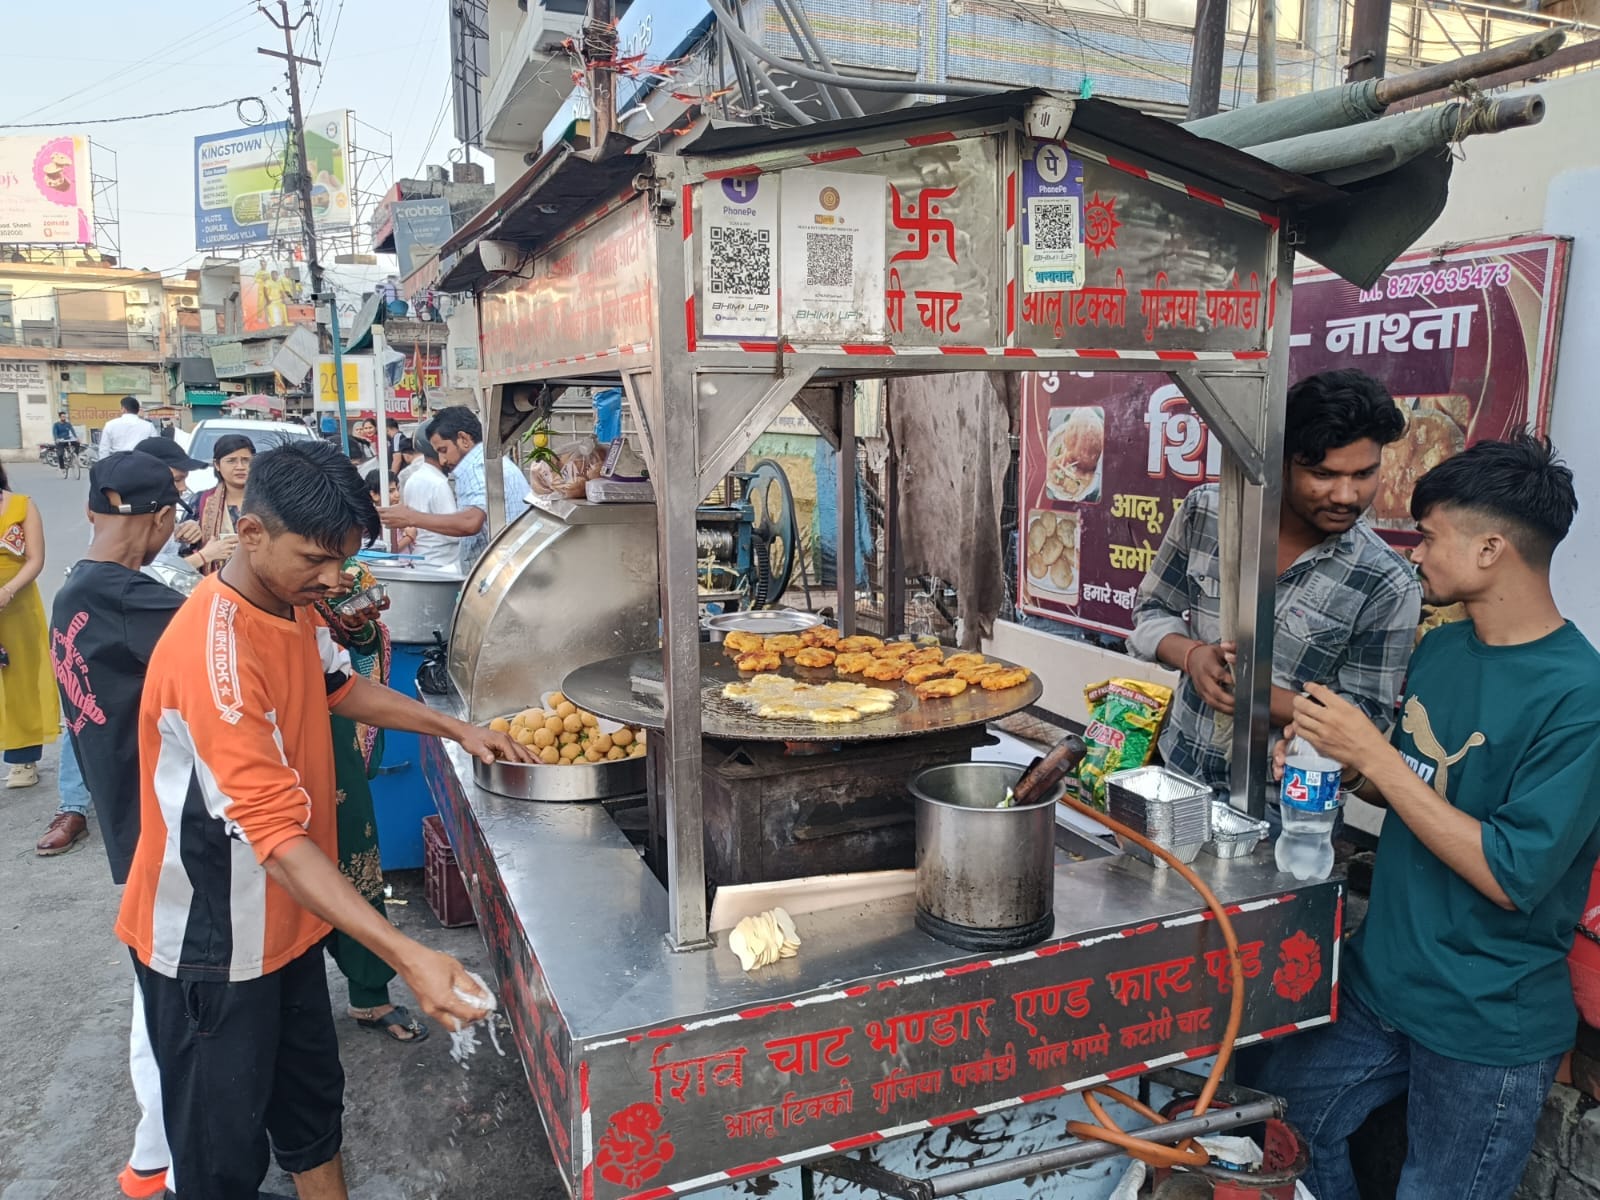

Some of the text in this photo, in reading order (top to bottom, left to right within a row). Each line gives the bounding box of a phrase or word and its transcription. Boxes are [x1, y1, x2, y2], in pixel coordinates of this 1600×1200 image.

[201, 139, 262, 160] KINGSTOWN
[1039, 185, 1067, 193] PhonePe
[723, 206, 757, 216] PhonePe
[205, 224, 228, 233] DUPLEX
[206, 229, 257, 243] LUXURIOUS VILLA
[1035, 271, 1075, 284] धन्यवाद
[1387, 263, 1512, 299] 8279635473
[712, 302, 742, 311] BHIM
[796, 310, 830, 320] BHIM
[914, 290, 963, 334] चाट
[1325, 304, 1479, 356] नाश्ता
[1083, 582, 1112, 604] हमारे
[648, 1042, 748, 1105] शिव
[764, 1026, 854, 1076] चाट
[865, 999, 996, 1057] भण्डार
[1011, 978, 1095, 1037] एण्ड
[1106, 956, 1196, 1006] फास्ट
[723, 1105, 776, 1139] आलू
[1028, 1035, 1069, 1071] गोल
[1119, 1006, 1173, 1049] कटोरी
[1176, 1007, 1213, 1034] चाट
